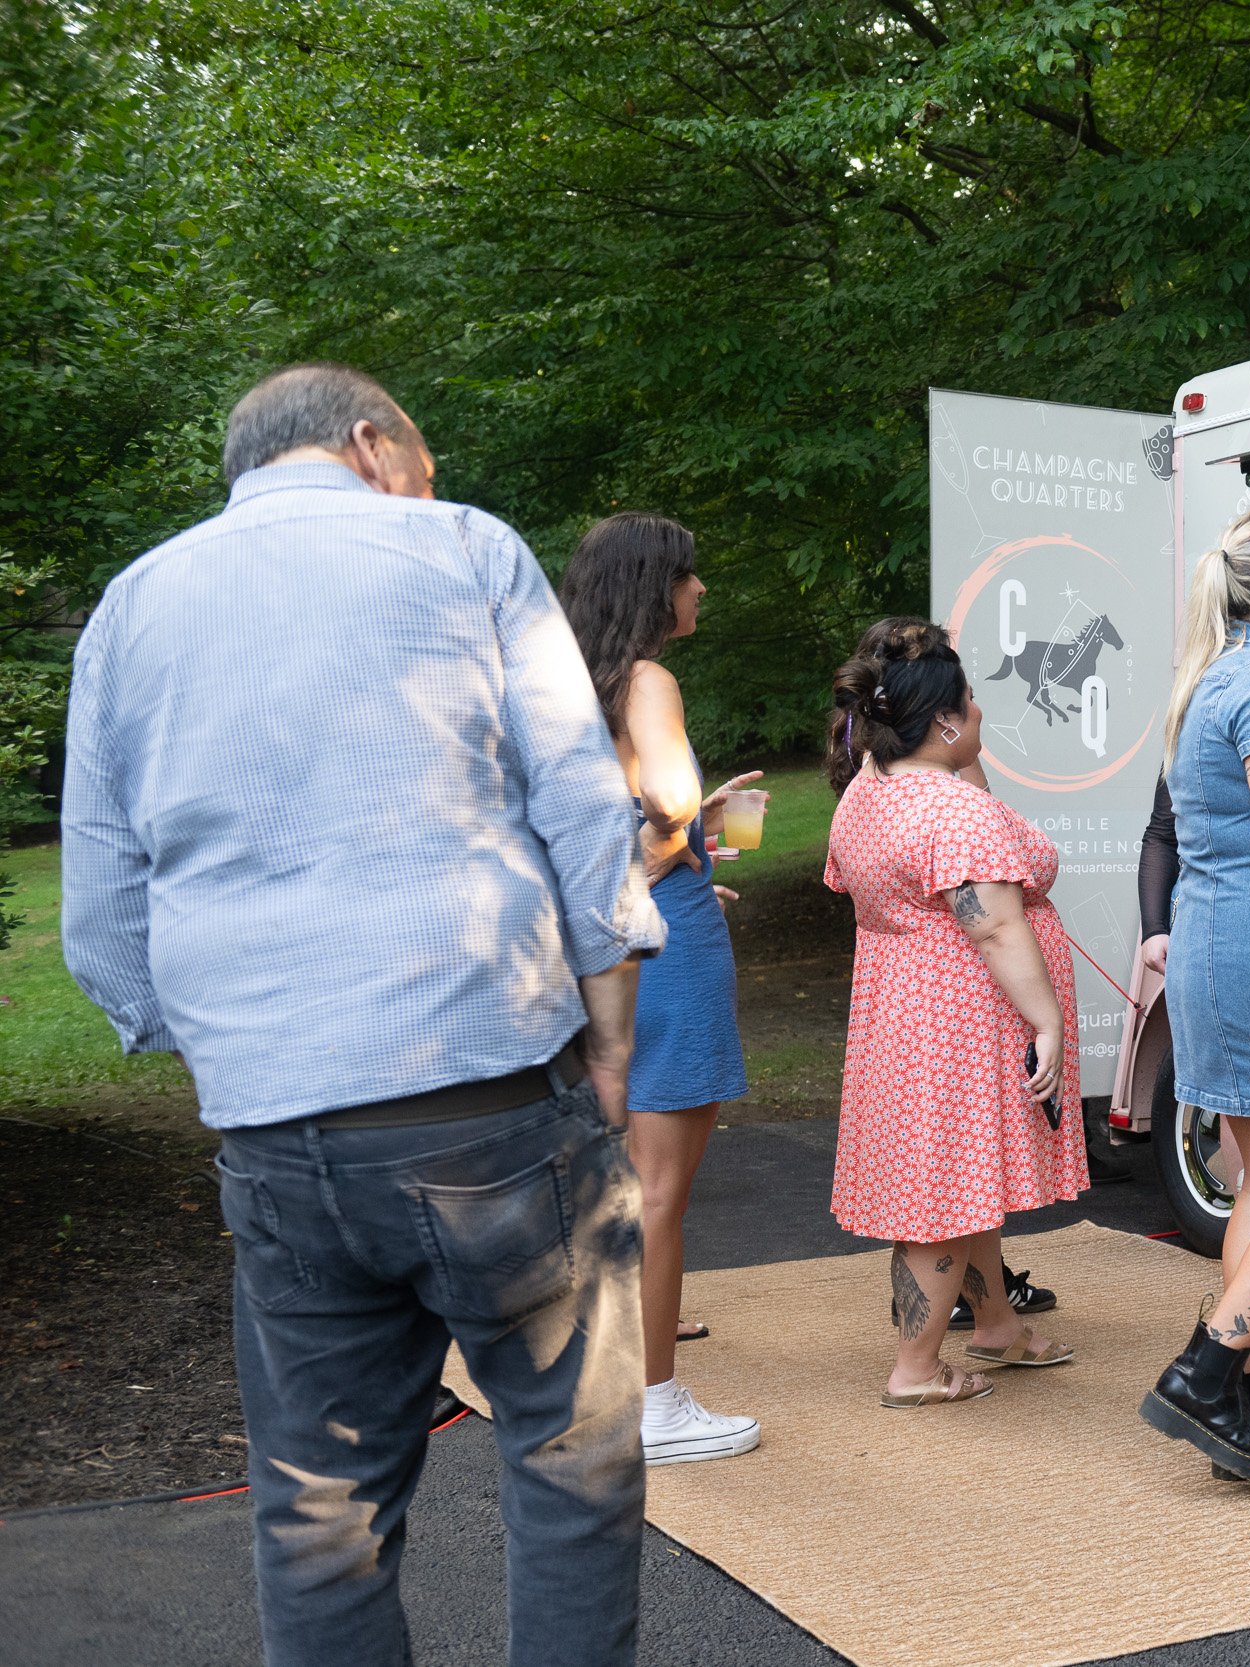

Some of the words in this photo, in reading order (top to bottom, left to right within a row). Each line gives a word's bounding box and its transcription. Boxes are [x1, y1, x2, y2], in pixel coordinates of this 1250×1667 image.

[973, 445, 1137, 484] CHAMPAGNE
[991, 478, 1125, 512] QUARTERS
[1000, 579, 1027, 657] C
[1081, 675, 1107, 758] Q
